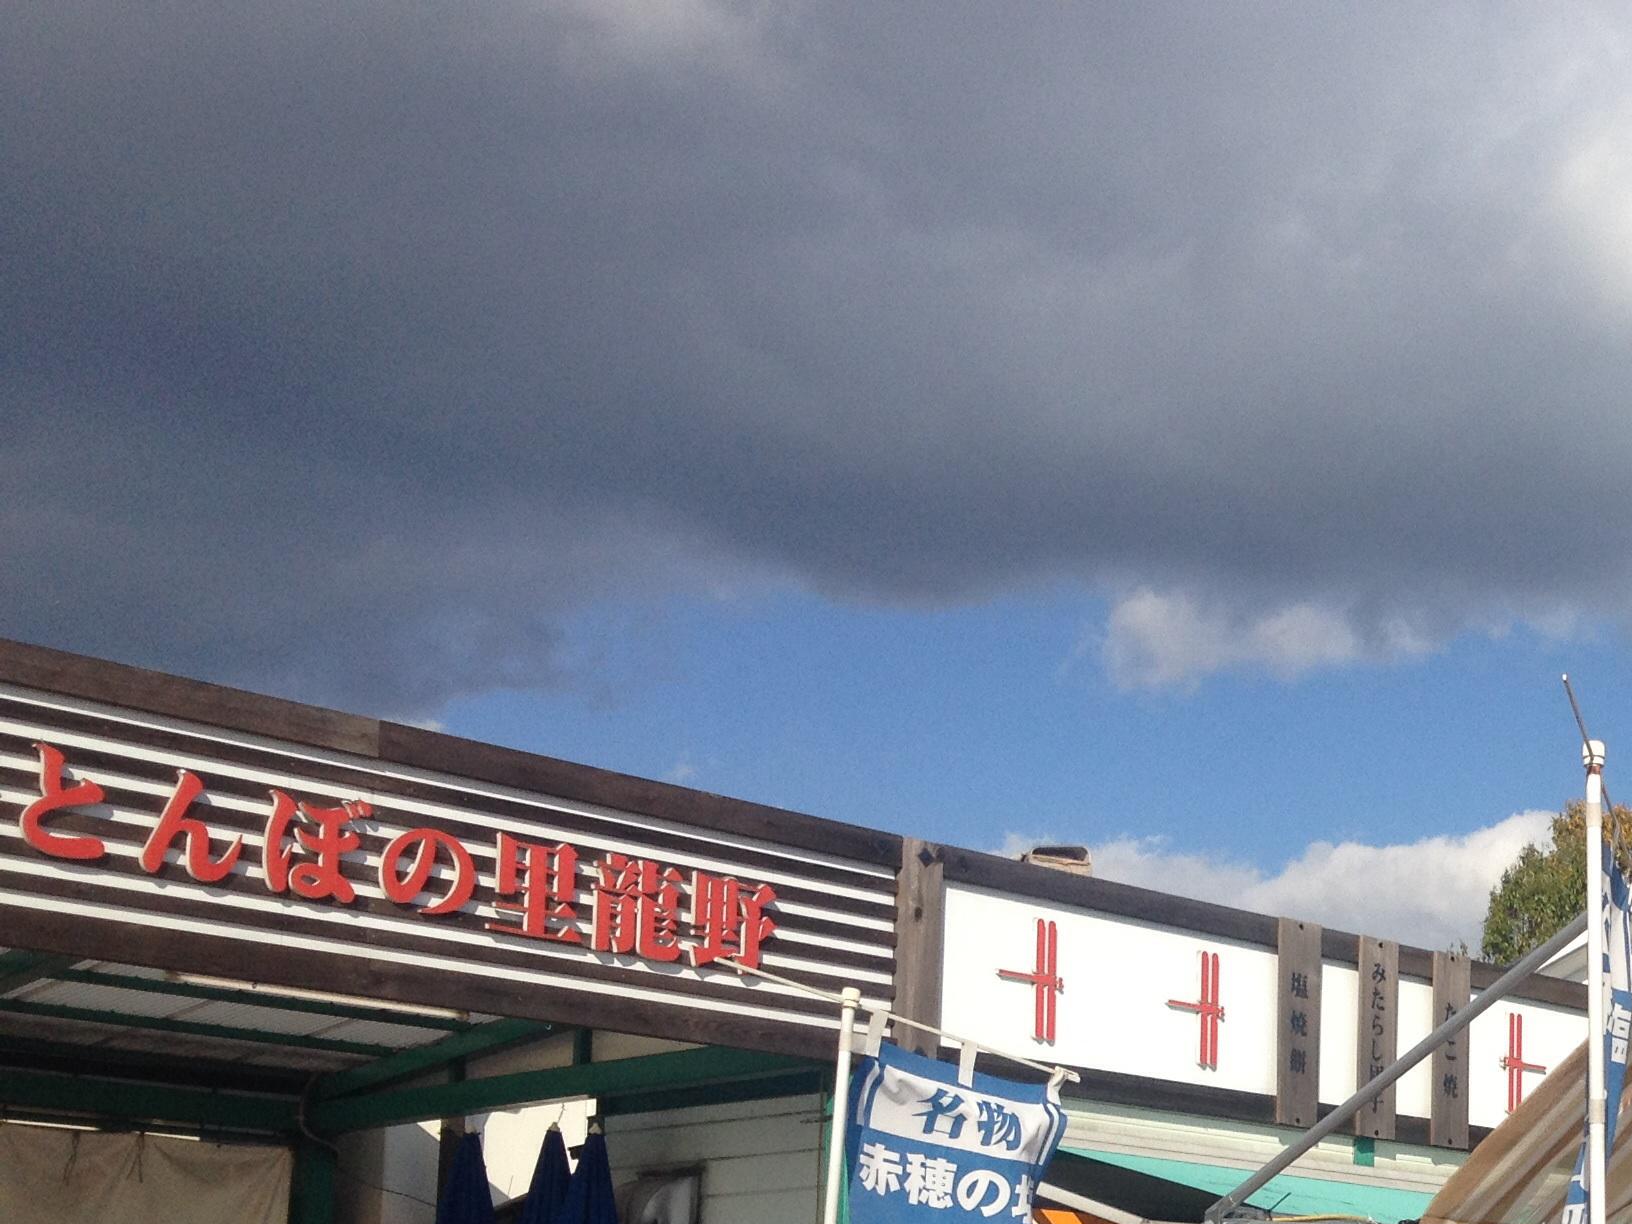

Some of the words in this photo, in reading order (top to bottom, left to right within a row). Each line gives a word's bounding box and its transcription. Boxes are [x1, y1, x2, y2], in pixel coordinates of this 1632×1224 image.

[19, 740, 778, 975] とんぼの里龍野
[911, 1087, 1024, 1152] 名物
